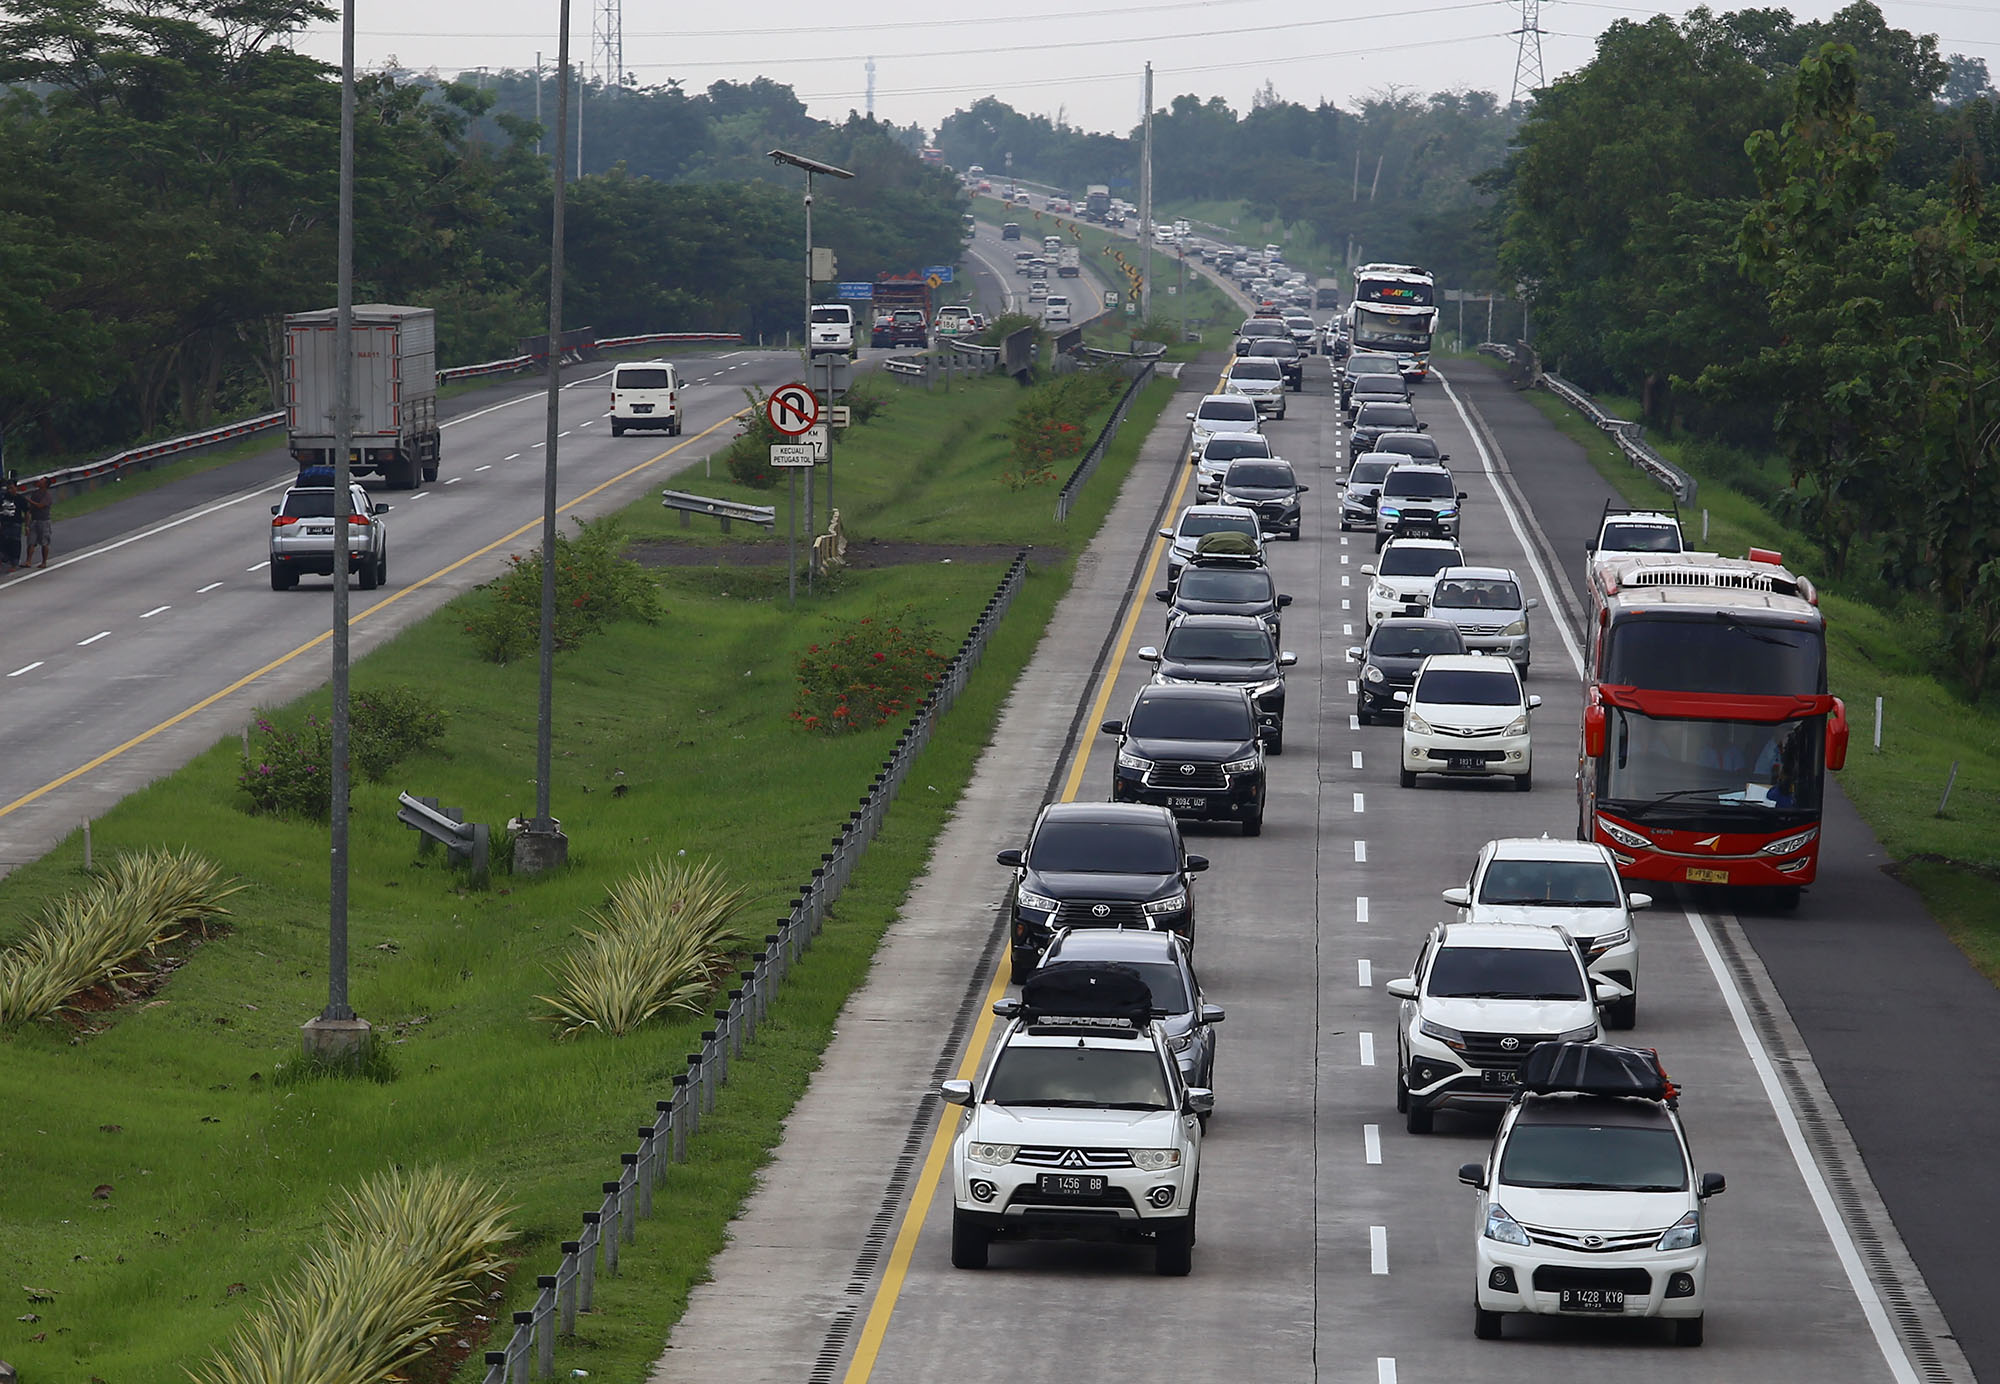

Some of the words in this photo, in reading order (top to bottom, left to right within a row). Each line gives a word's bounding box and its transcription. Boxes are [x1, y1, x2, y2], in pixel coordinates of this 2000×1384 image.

[1485, 1072, 1490, 1081] E
[1042, 1177, 1048, 1187] F
[1059, 1178, 1080, 1189] 1456
[1090, 1179, 1102, 1190] BB
[1564, 1291, 1570, 1302] B
[1577, 1291, 1599, 1303] 1428
